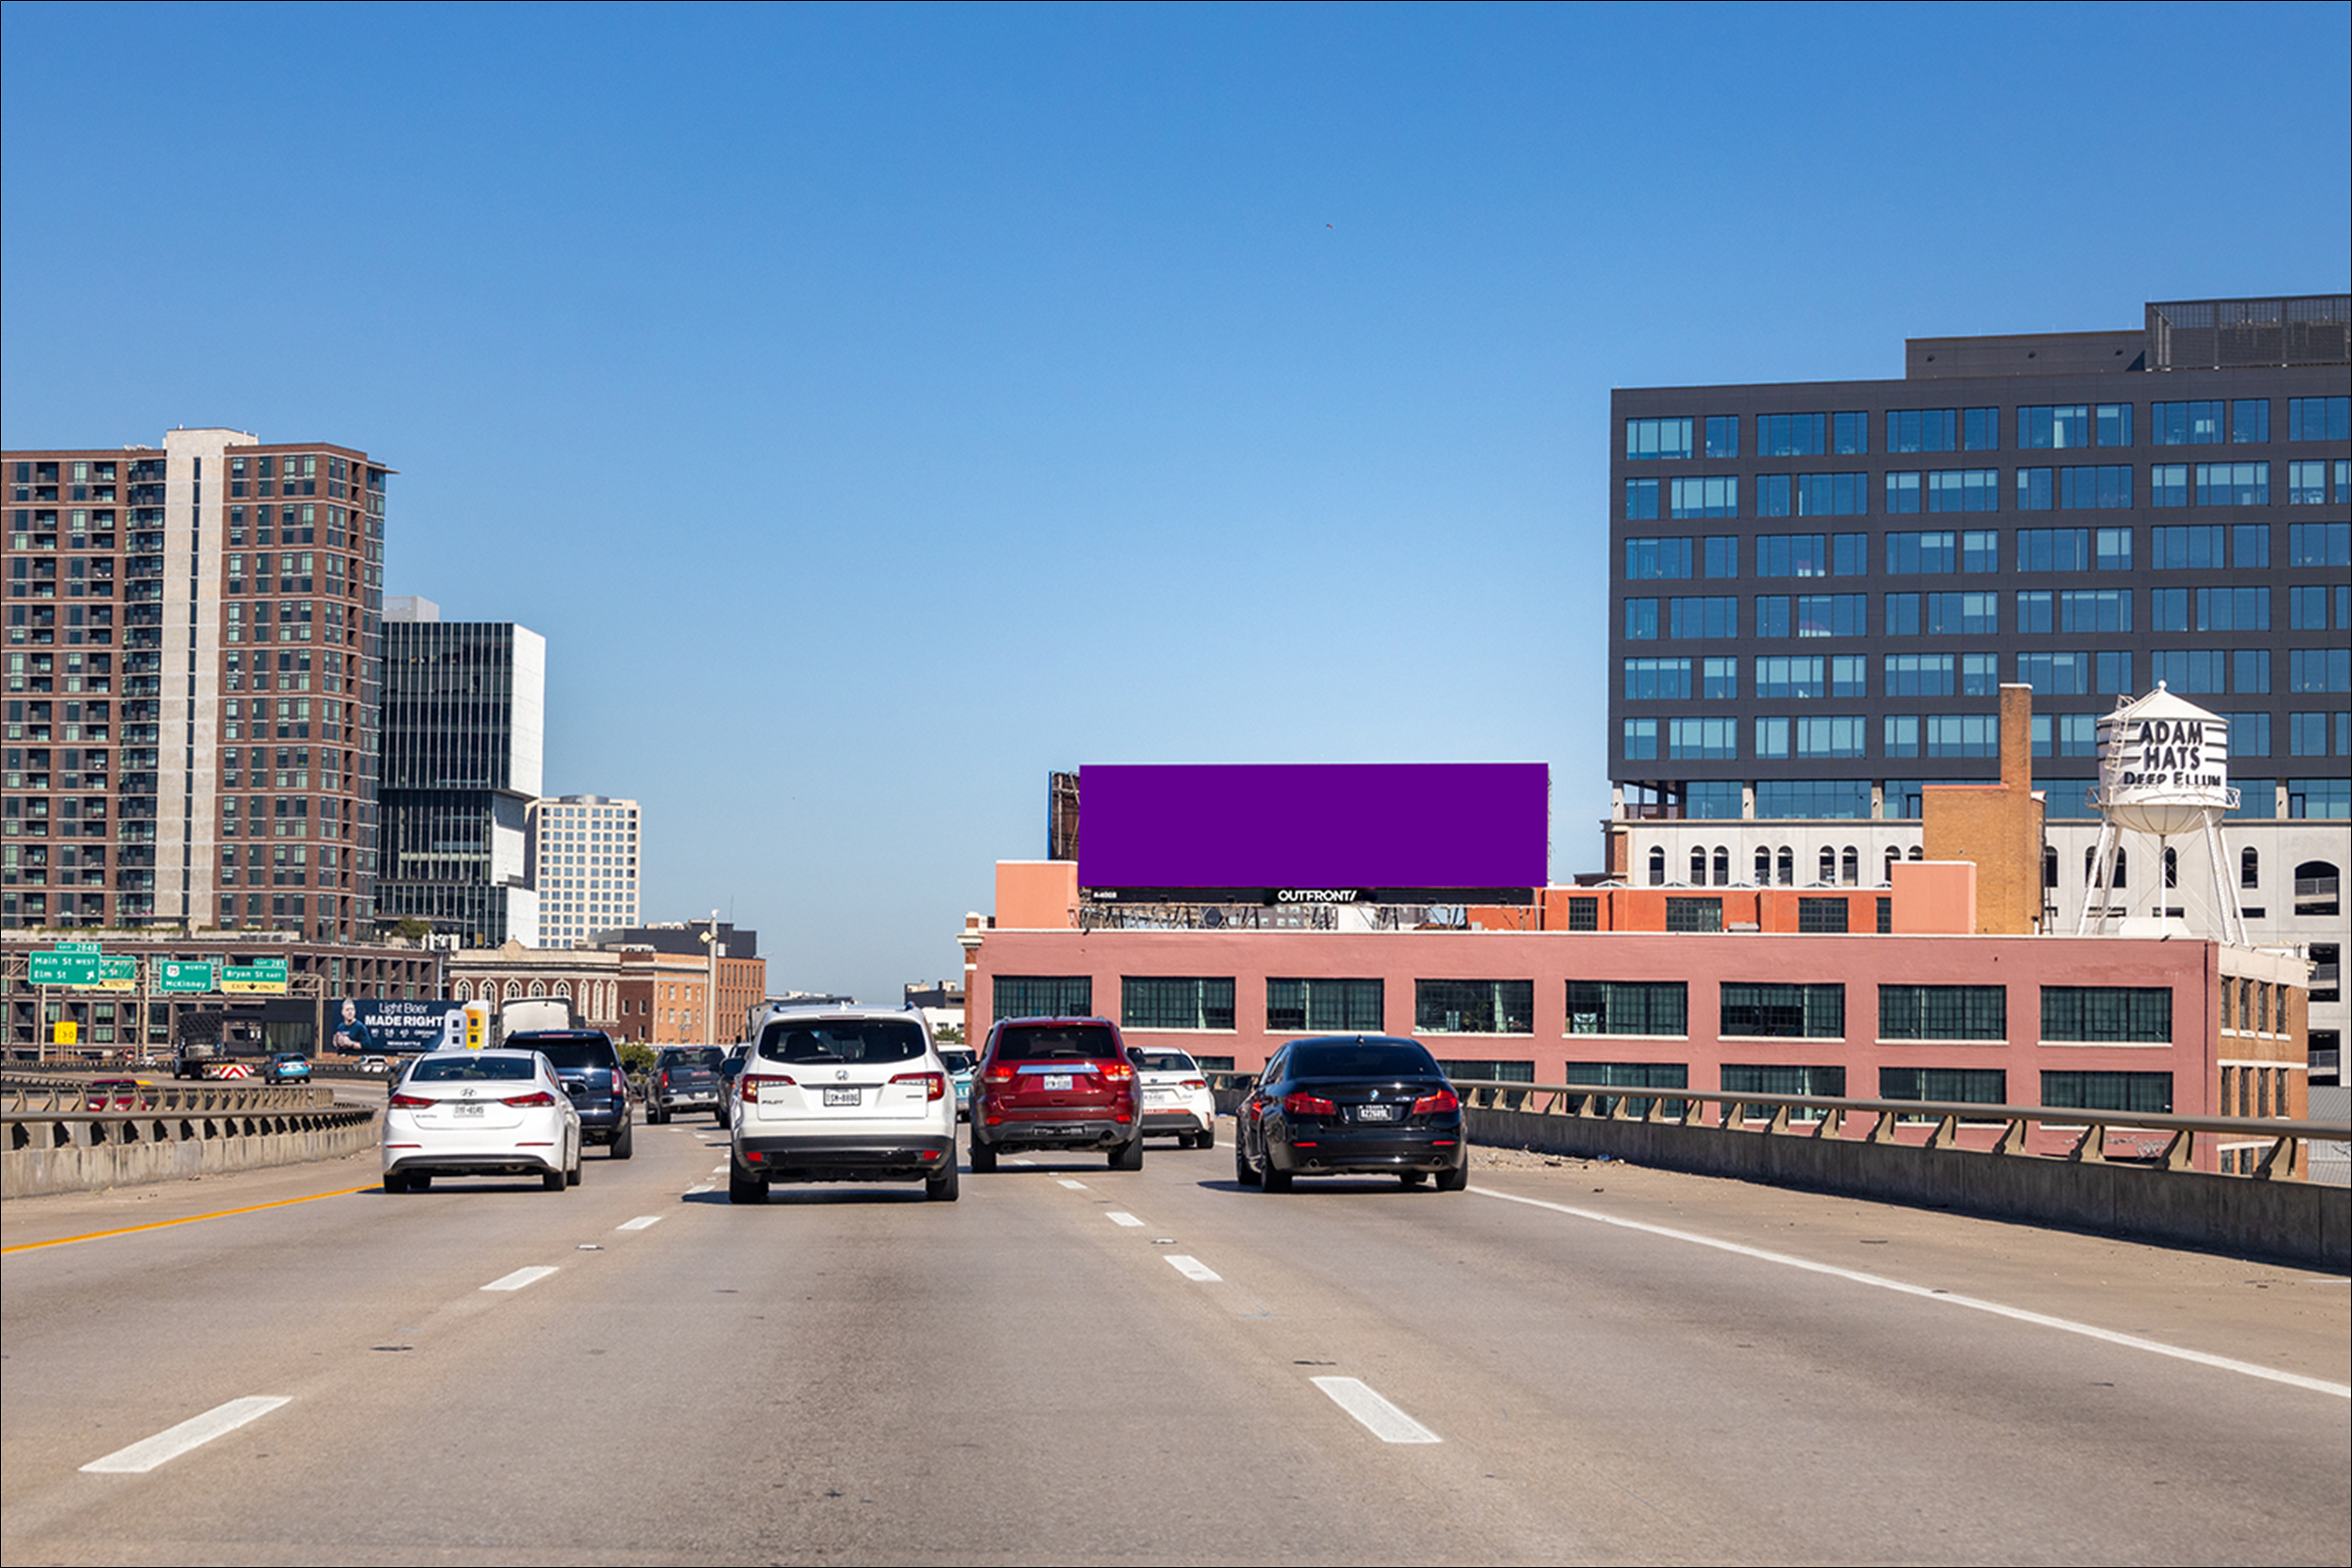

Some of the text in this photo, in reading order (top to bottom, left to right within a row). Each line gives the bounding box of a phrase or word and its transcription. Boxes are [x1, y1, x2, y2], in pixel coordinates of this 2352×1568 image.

[2139, 721, 2204, 745] ADAM
[2143, 747, 2201, 771] HATS
[33, 956, 59, 965] Main
[62, 956, 73, 966] St
[33, 970, 67, 979] Elm St
[226, 969, 251, 979] Bryan
[166, 980, 207, 989] McKinney
[378, 1003, 428, 1015] Light Beer
[365, 1015, 444, 1027] MADE RIGHT
